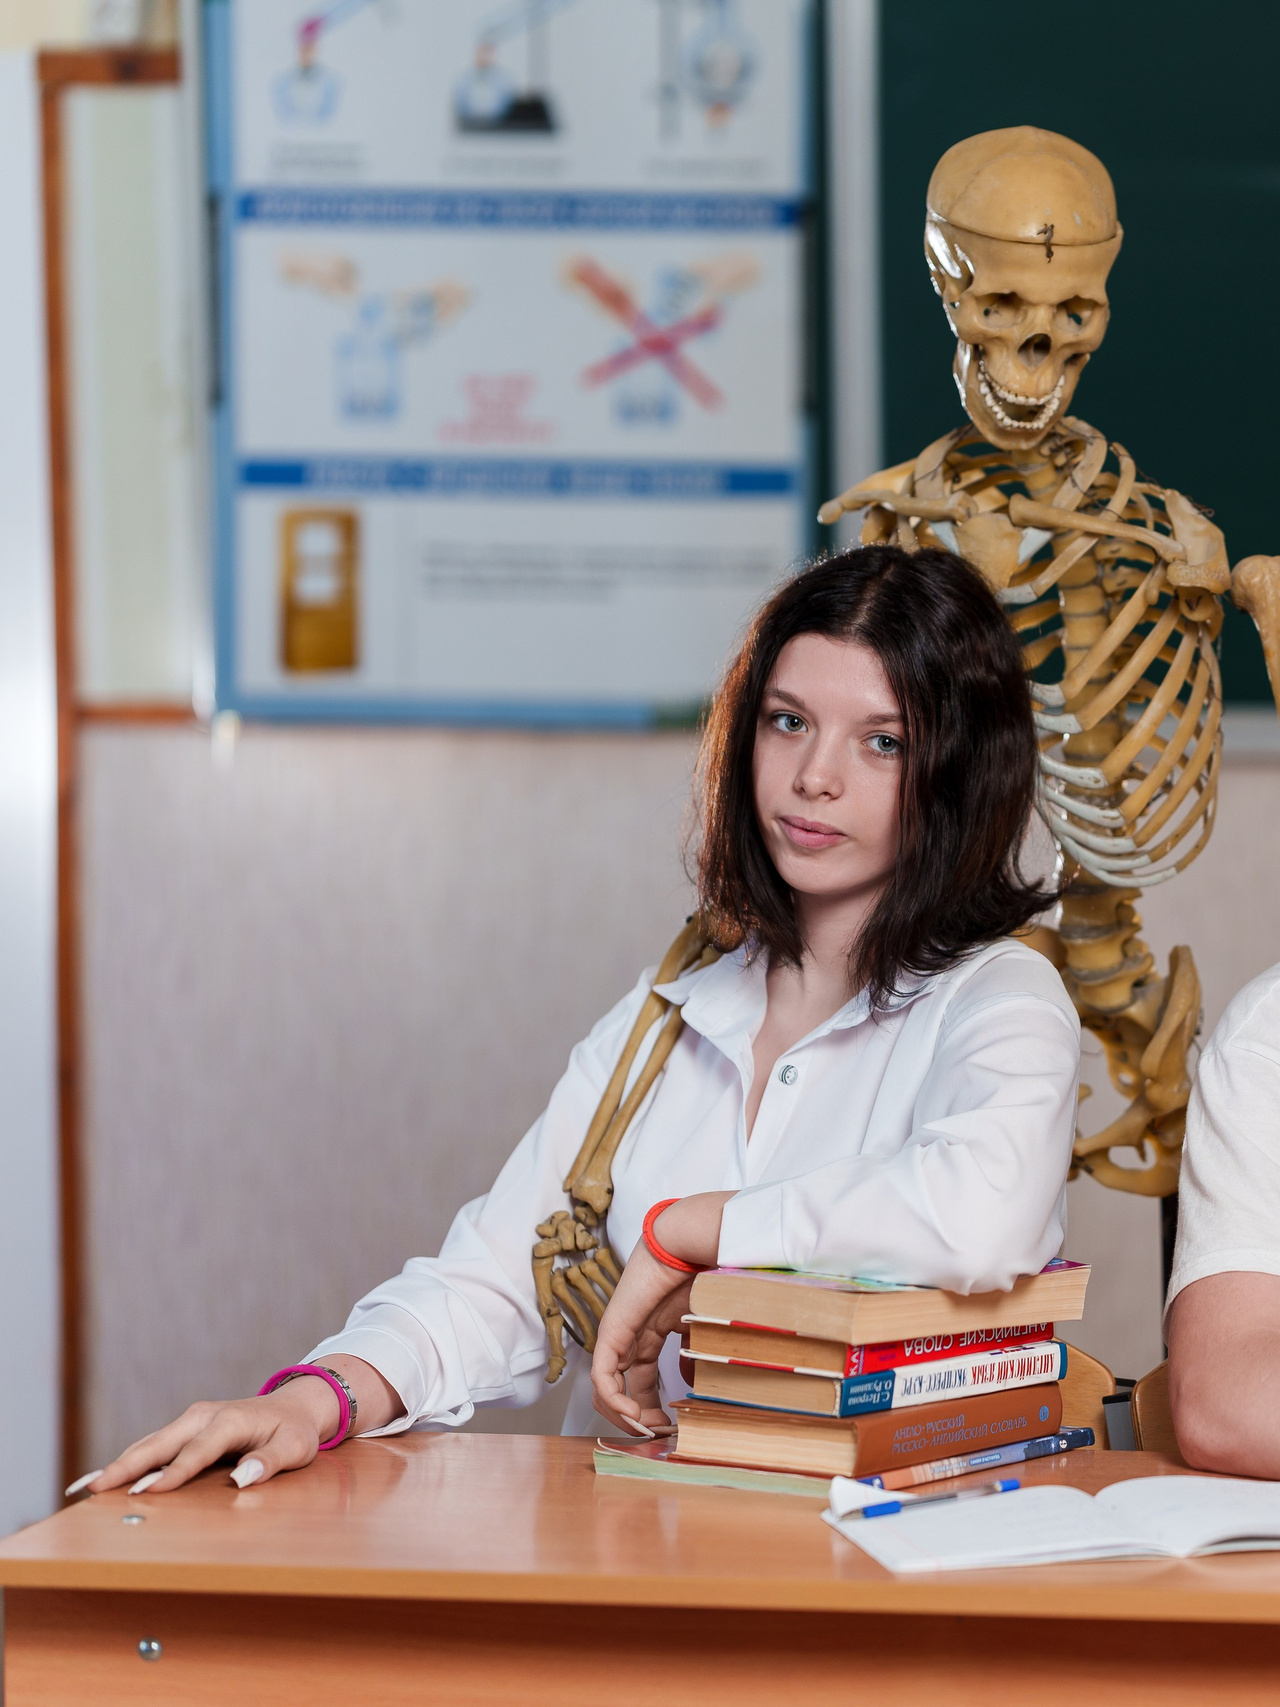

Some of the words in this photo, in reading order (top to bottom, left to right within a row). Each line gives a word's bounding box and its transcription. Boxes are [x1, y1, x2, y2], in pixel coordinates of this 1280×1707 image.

[903, 1333, 954, 1358] СЛОВА
[970, 1362, 996, 1386] ЯЗЫК
[996, 1353, 1055, 1384] АНГЛИЙСКИЙ
[901, 1368, 967, 1397] ЭКСПРЕСС-КУРС
[989, 1416, 1028, 1435] СЛОВАРЬ
